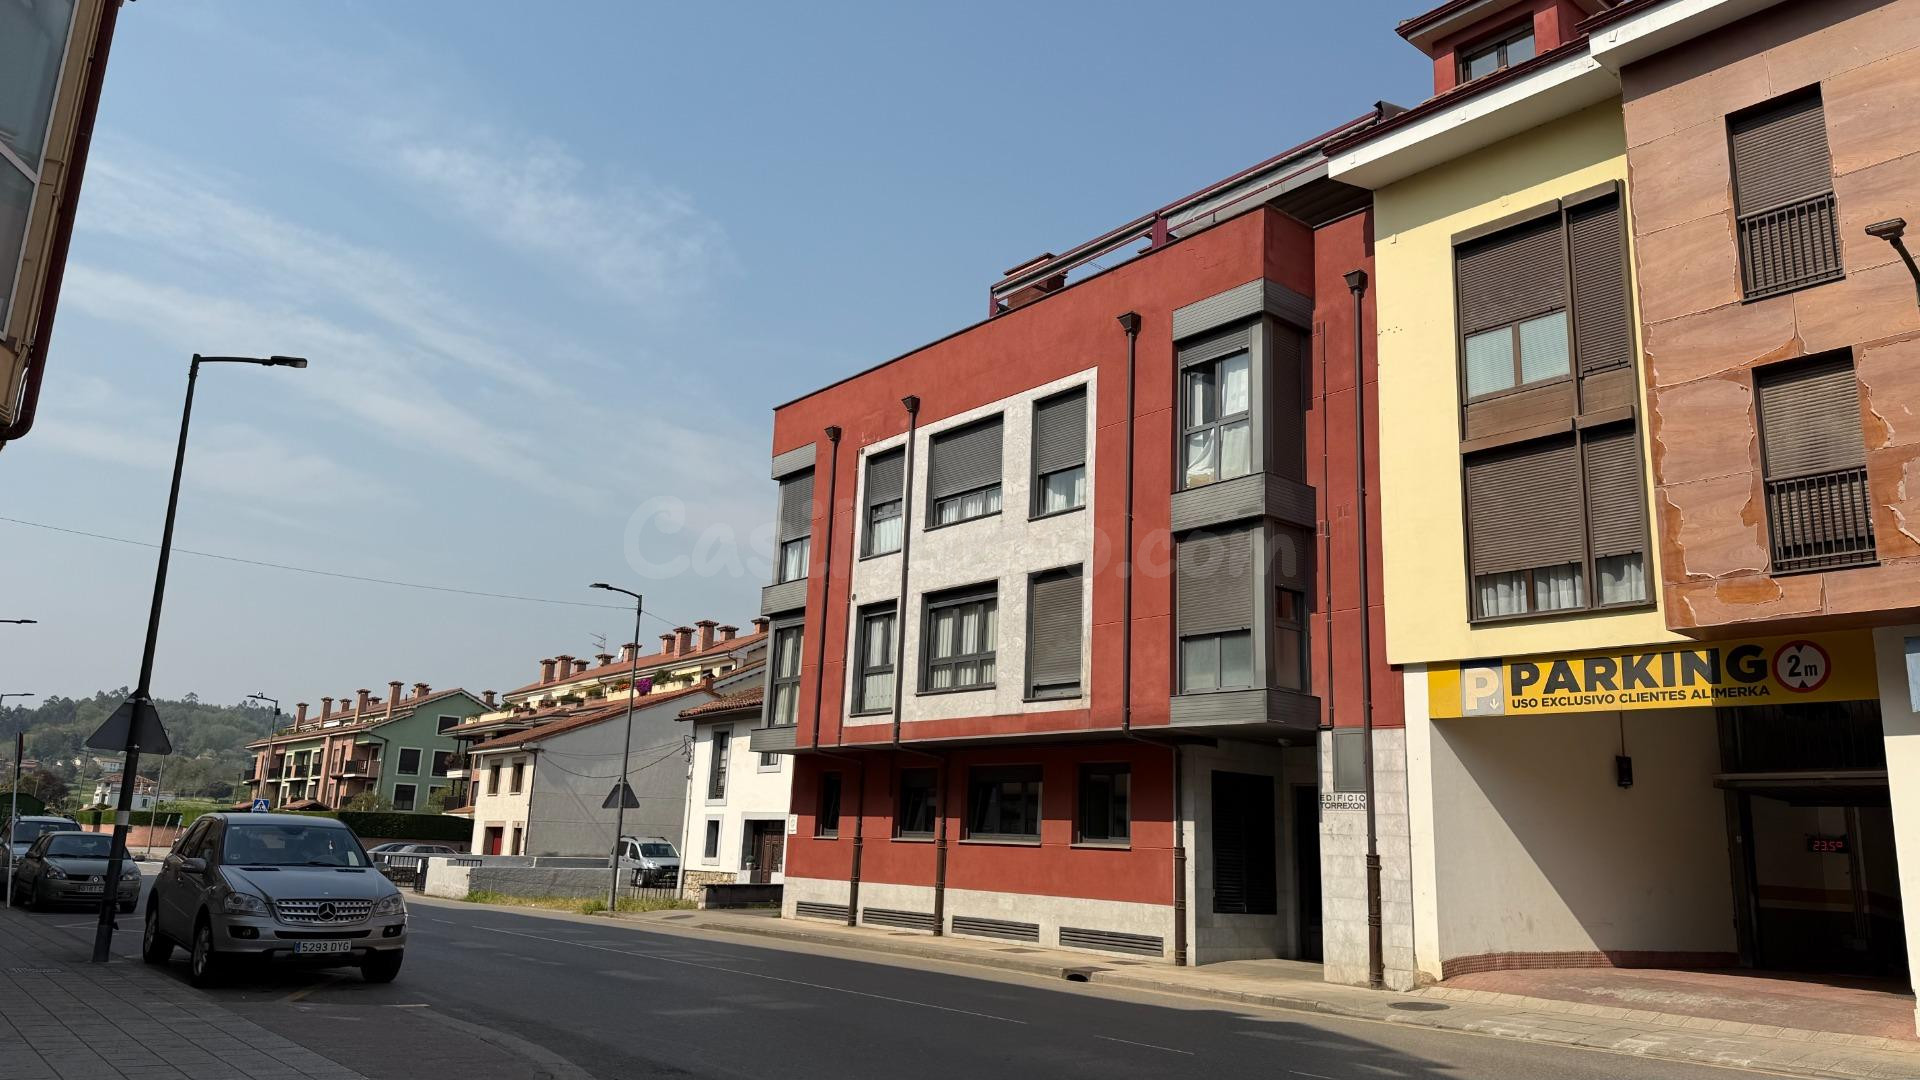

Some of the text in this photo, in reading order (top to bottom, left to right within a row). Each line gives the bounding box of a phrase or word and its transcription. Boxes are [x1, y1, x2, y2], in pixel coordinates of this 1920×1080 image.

[1510, 644, 1768, 696] PARKING
[1787, 655, 1818, 678] 2 m
[1464, 666, 1499, 710] P
[1512, 685, 1770, 709] USO EXCLUSIVO CLIENTES ALIMERKA
[1320, 794, 1366, 802] EDIFICIO
[1320, 802, 1366, 810] TORREXON
[302, 942, 349, 952] 5293 DYG
